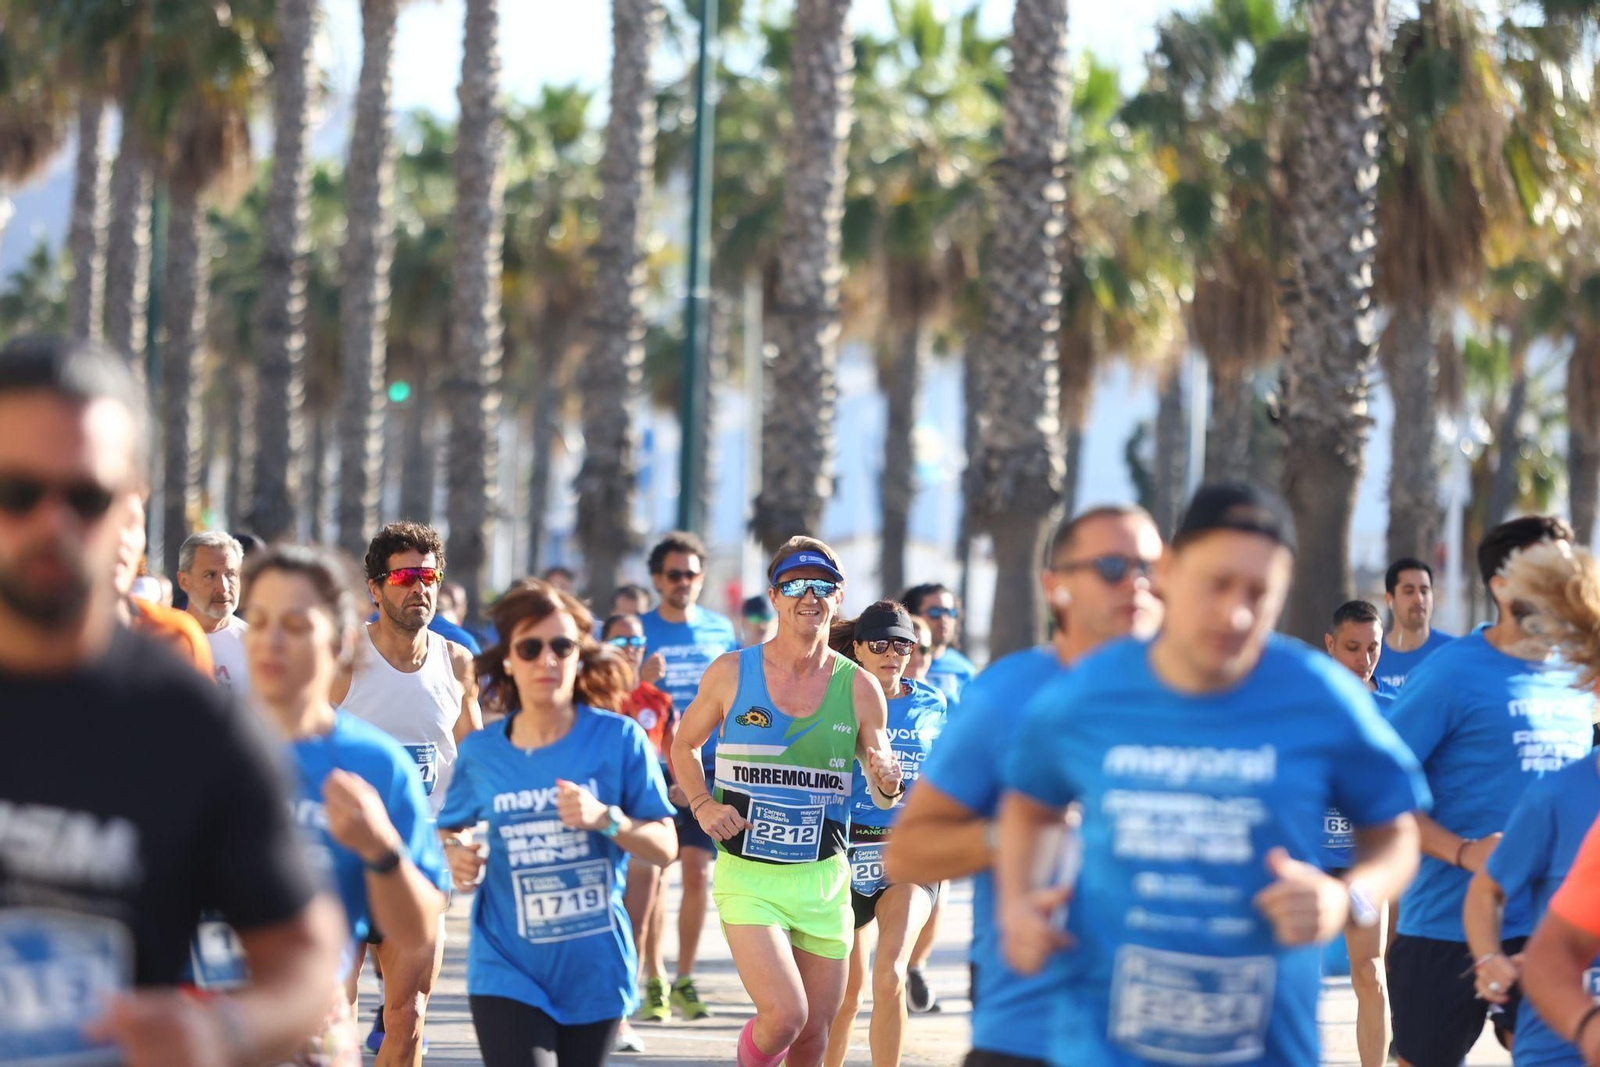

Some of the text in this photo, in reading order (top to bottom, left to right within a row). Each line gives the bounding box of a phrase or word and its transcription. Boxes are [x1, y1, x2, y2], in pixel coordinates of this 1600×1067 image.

[493, 778, 599, 813] mayol
[756, 822, 814, 843] 2212
[531, 887, 600, 916] 1719
